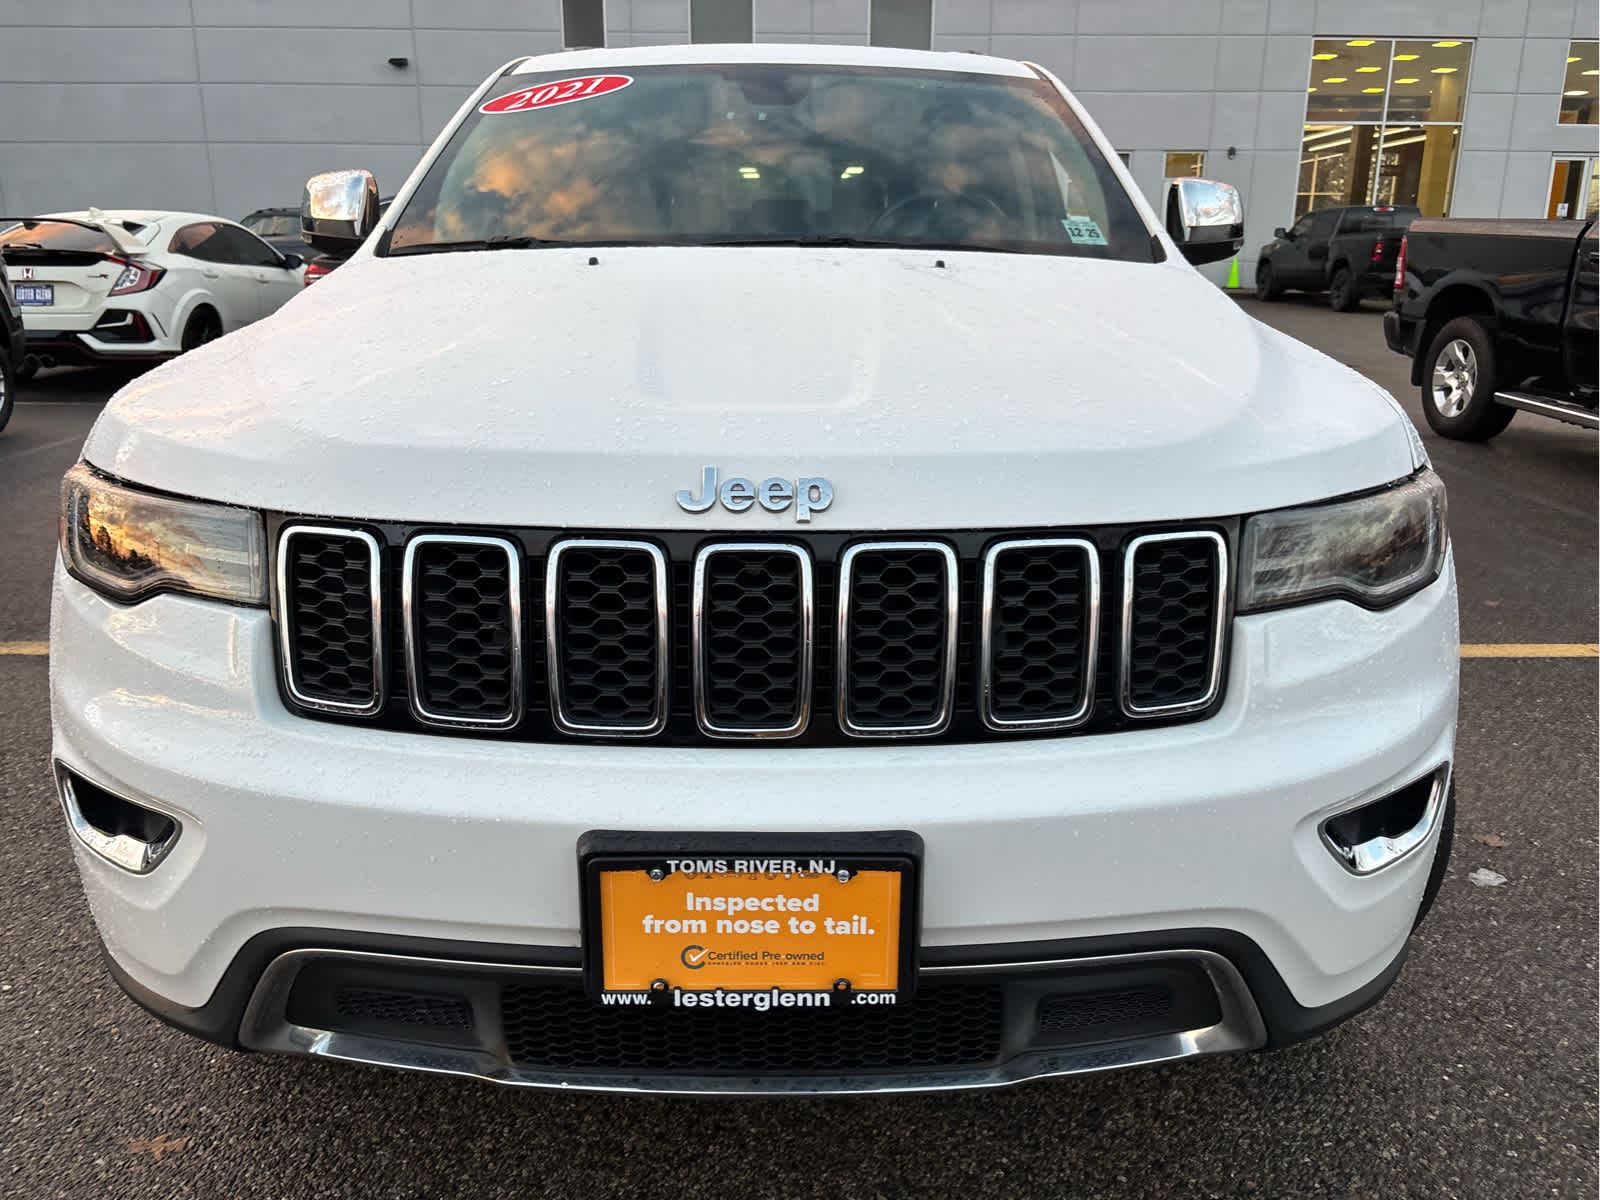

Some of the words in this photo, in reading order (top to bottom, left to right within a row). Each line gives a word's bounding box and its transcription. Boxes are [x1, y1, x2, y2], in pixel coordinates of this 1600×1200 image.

[504, 77, 606, 111] 2021
[1068, 227, 1084, 237] 12
[675, 464, 834, 524] Jeep
[667, 860, 728, 873] TOMS
[734, 860, 802, 874] RIVER,
[809, 860, 836, 873] NJ
[686, 892, 820, 916] Inspected
[642, 914, 707, 934] from
[716, 919, 780, 934] nose
[788, 917, 816, 934] to
[824, 915, 875, 935] tail.
[707, 951, 758, 961] Certified
[762, 951, 825, 961] Pre-owned
[601, 992, 652, 1005] www.
[673, 989, 831, 1011] lesterglenn
[850, 991, 896, 1005] .com
